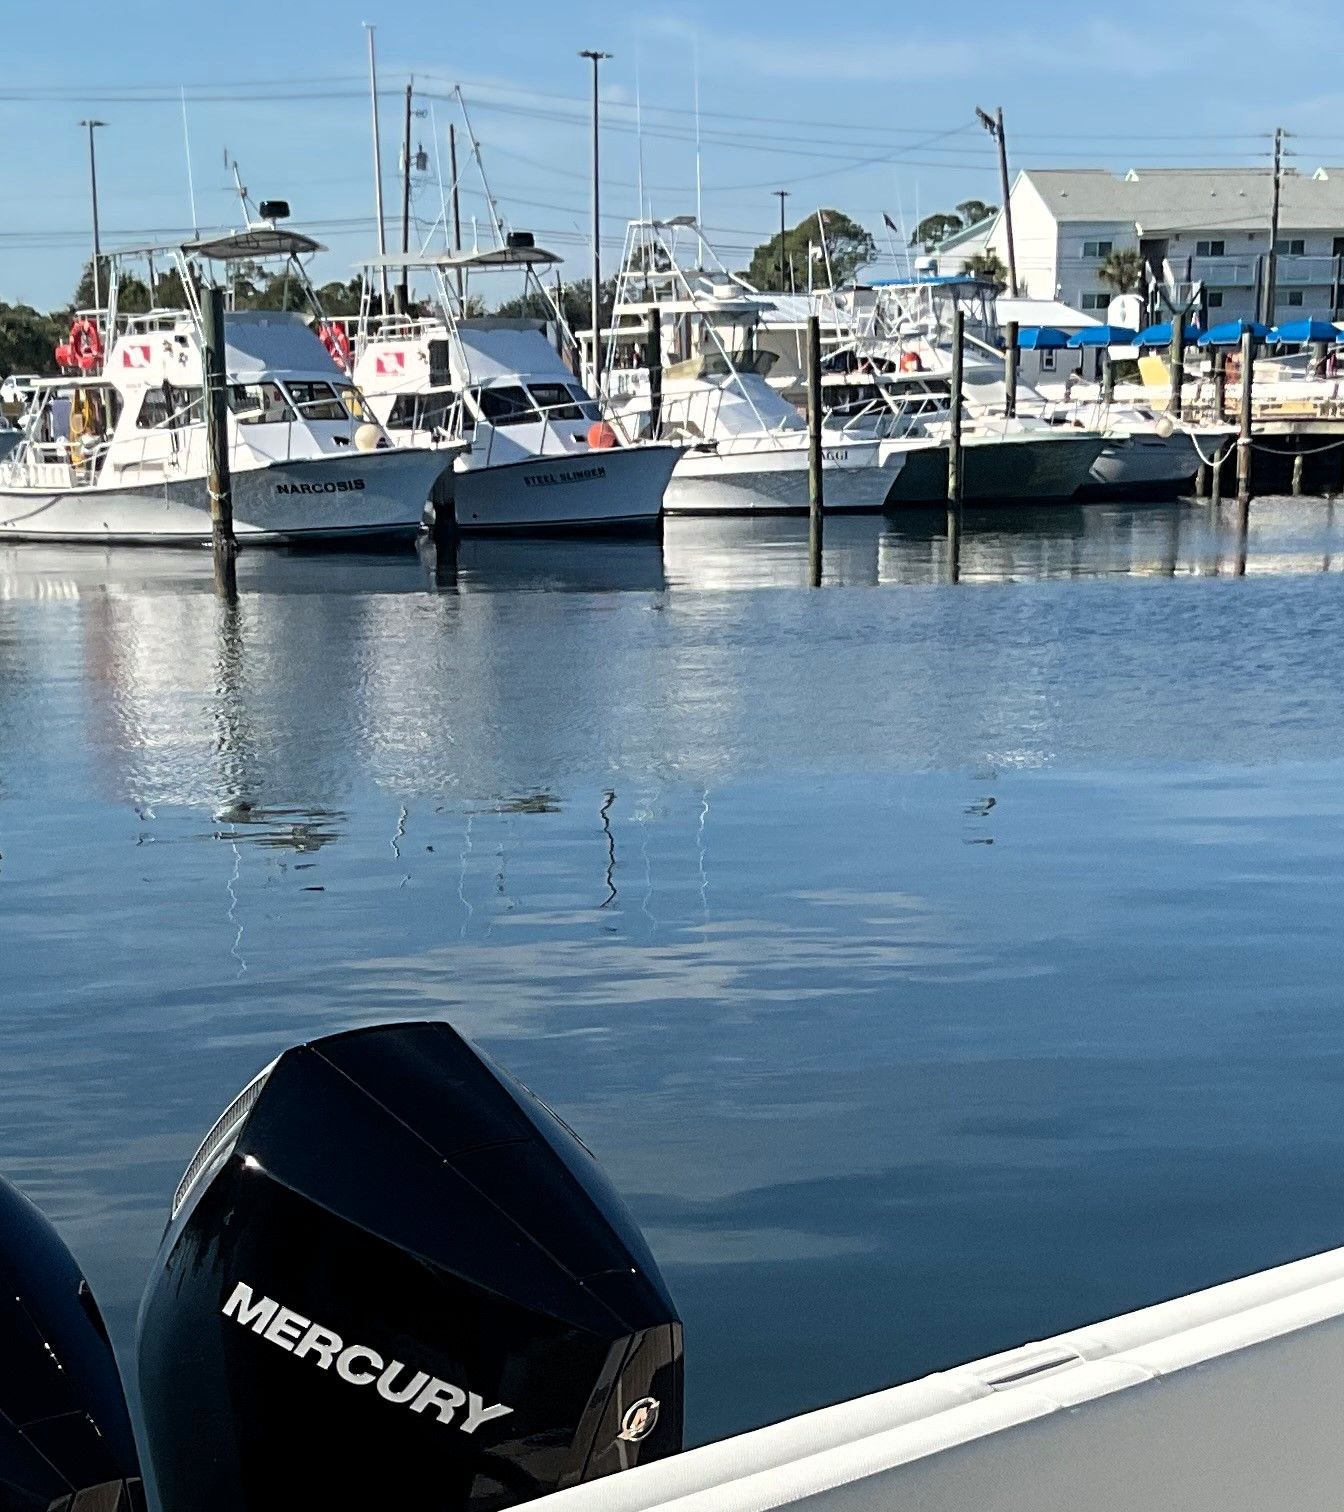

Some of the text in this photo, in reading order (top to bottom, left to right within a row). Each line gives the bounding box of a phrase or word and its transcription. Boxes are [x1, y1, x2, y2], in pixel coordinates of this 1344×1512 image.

[275, 478, 366, 495] NARCOSIS
[523, 473, 556, 487] STEEL
[221, 1281, 514, 1434] MERCURY
